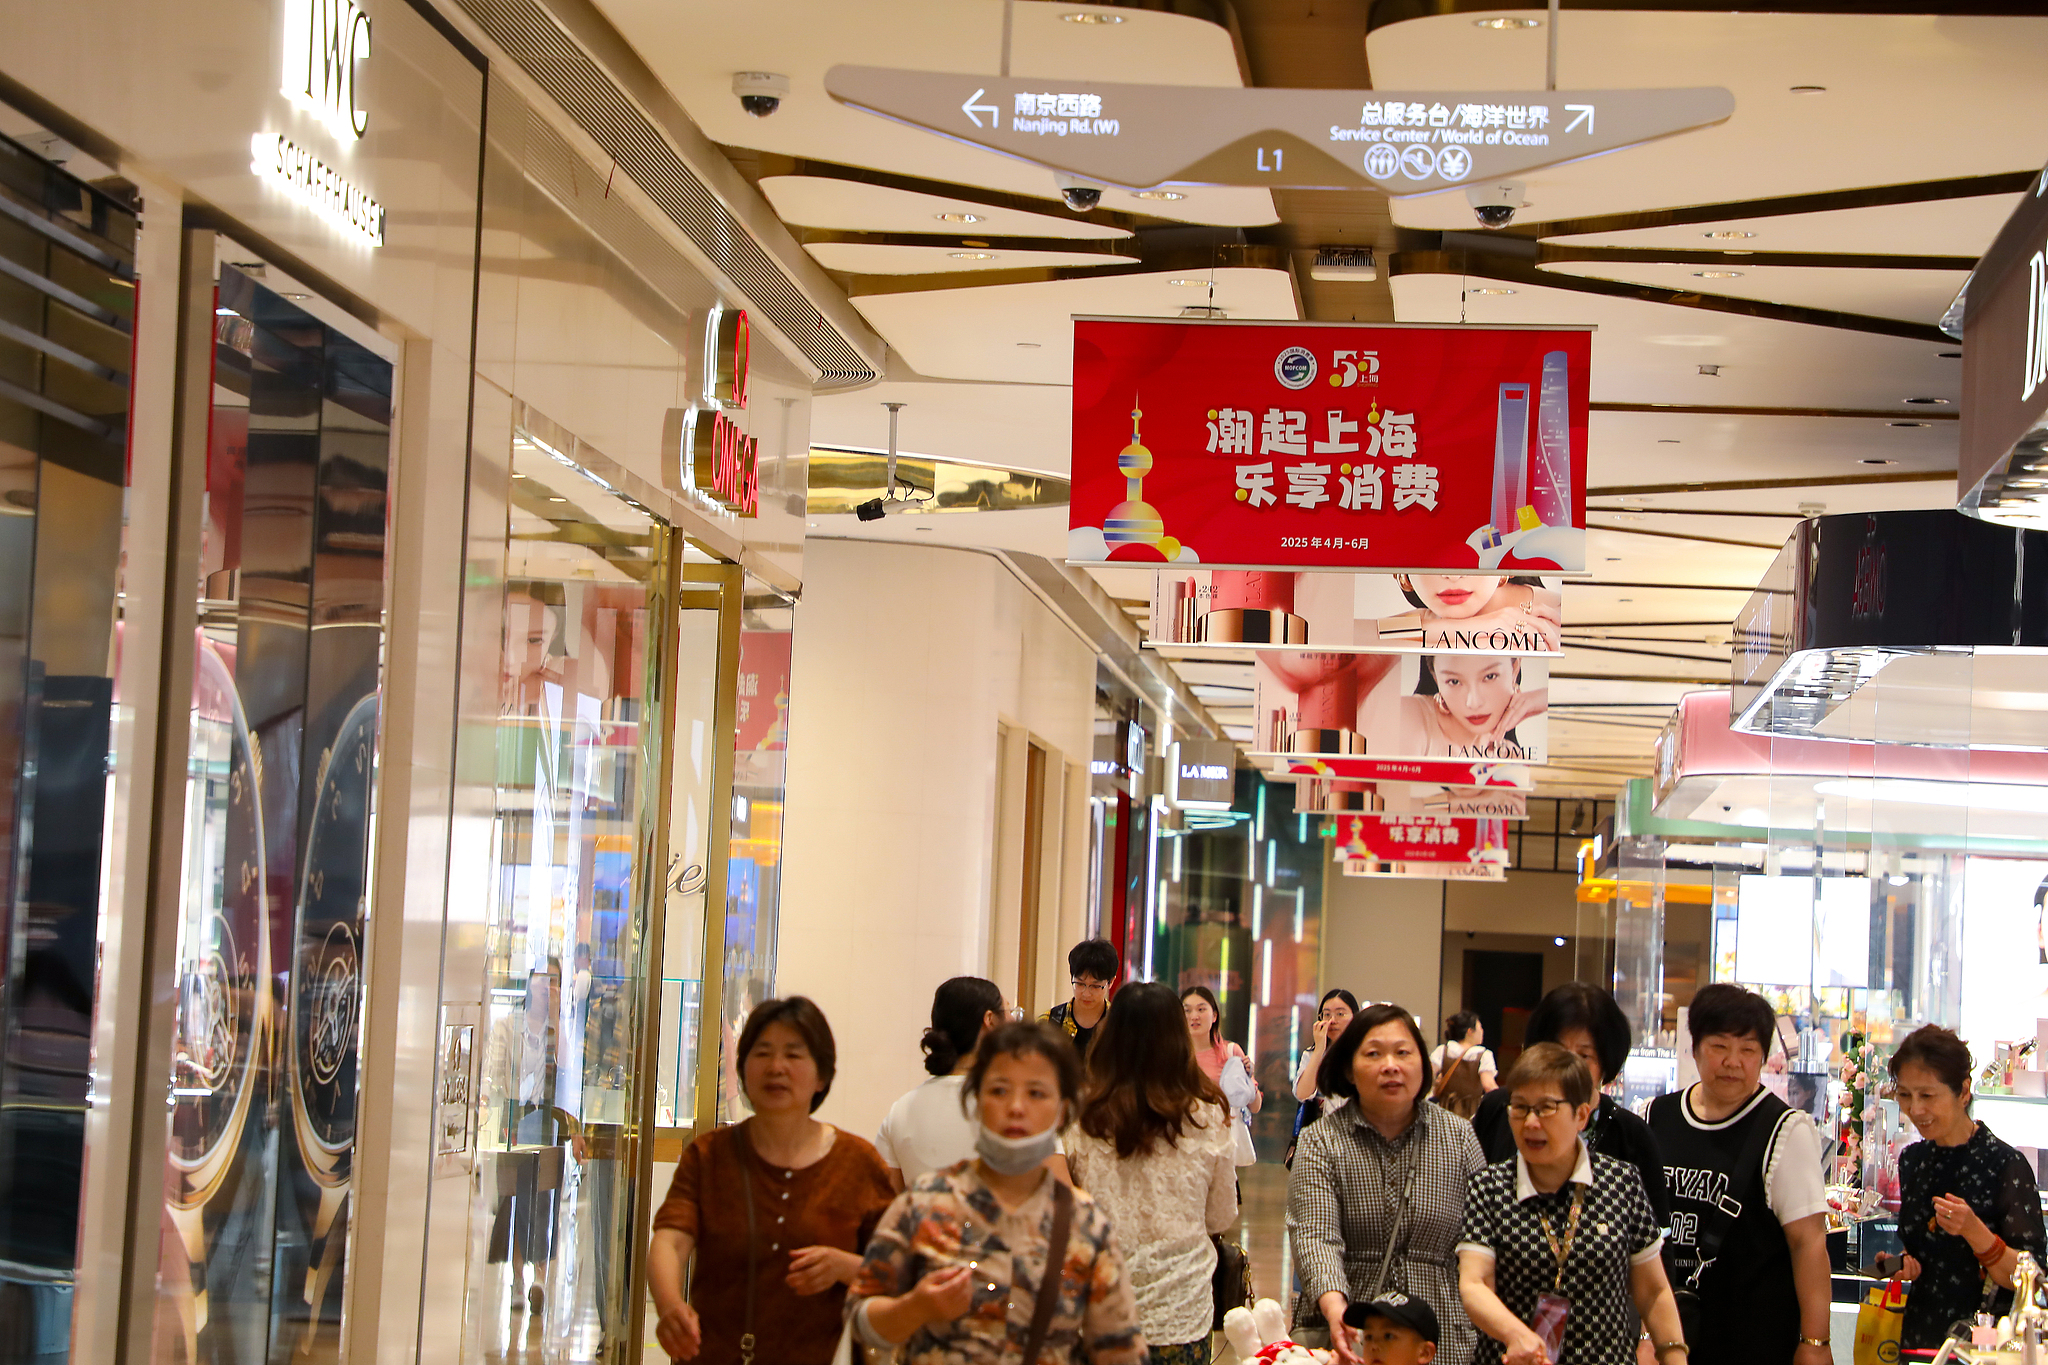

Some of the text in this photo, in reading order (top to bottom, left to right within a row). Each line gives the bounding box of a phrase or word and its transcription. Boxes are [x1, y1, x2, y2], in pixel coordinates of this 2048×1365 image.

[303, 0, 372, 140] IWC
[1014, 92, 1102, 118] 南京西路
[1361, 101, 1550, 130] 总服务台/海洋世界
[1013, 117, 1120, 136] Nanjing Rd. (W)
[1330, 125, 1381, 142] Service
[1383, 126, 1429, 143] Center
[1486, 128, 1501, 145] of
[1503, 130, 1549, 146] Ocean
[1256, 148, 1283, 172] L1
[276, 134, 386, 247] SCHAFFHAUSEN
[1206, 408, 1416, 458] 潮起上海
[710, 410, 760, 519] OMEGA
[1235, 463, 1440, 512] 乐享消费
[1421, 627, 1547, 652] LANCÔME
